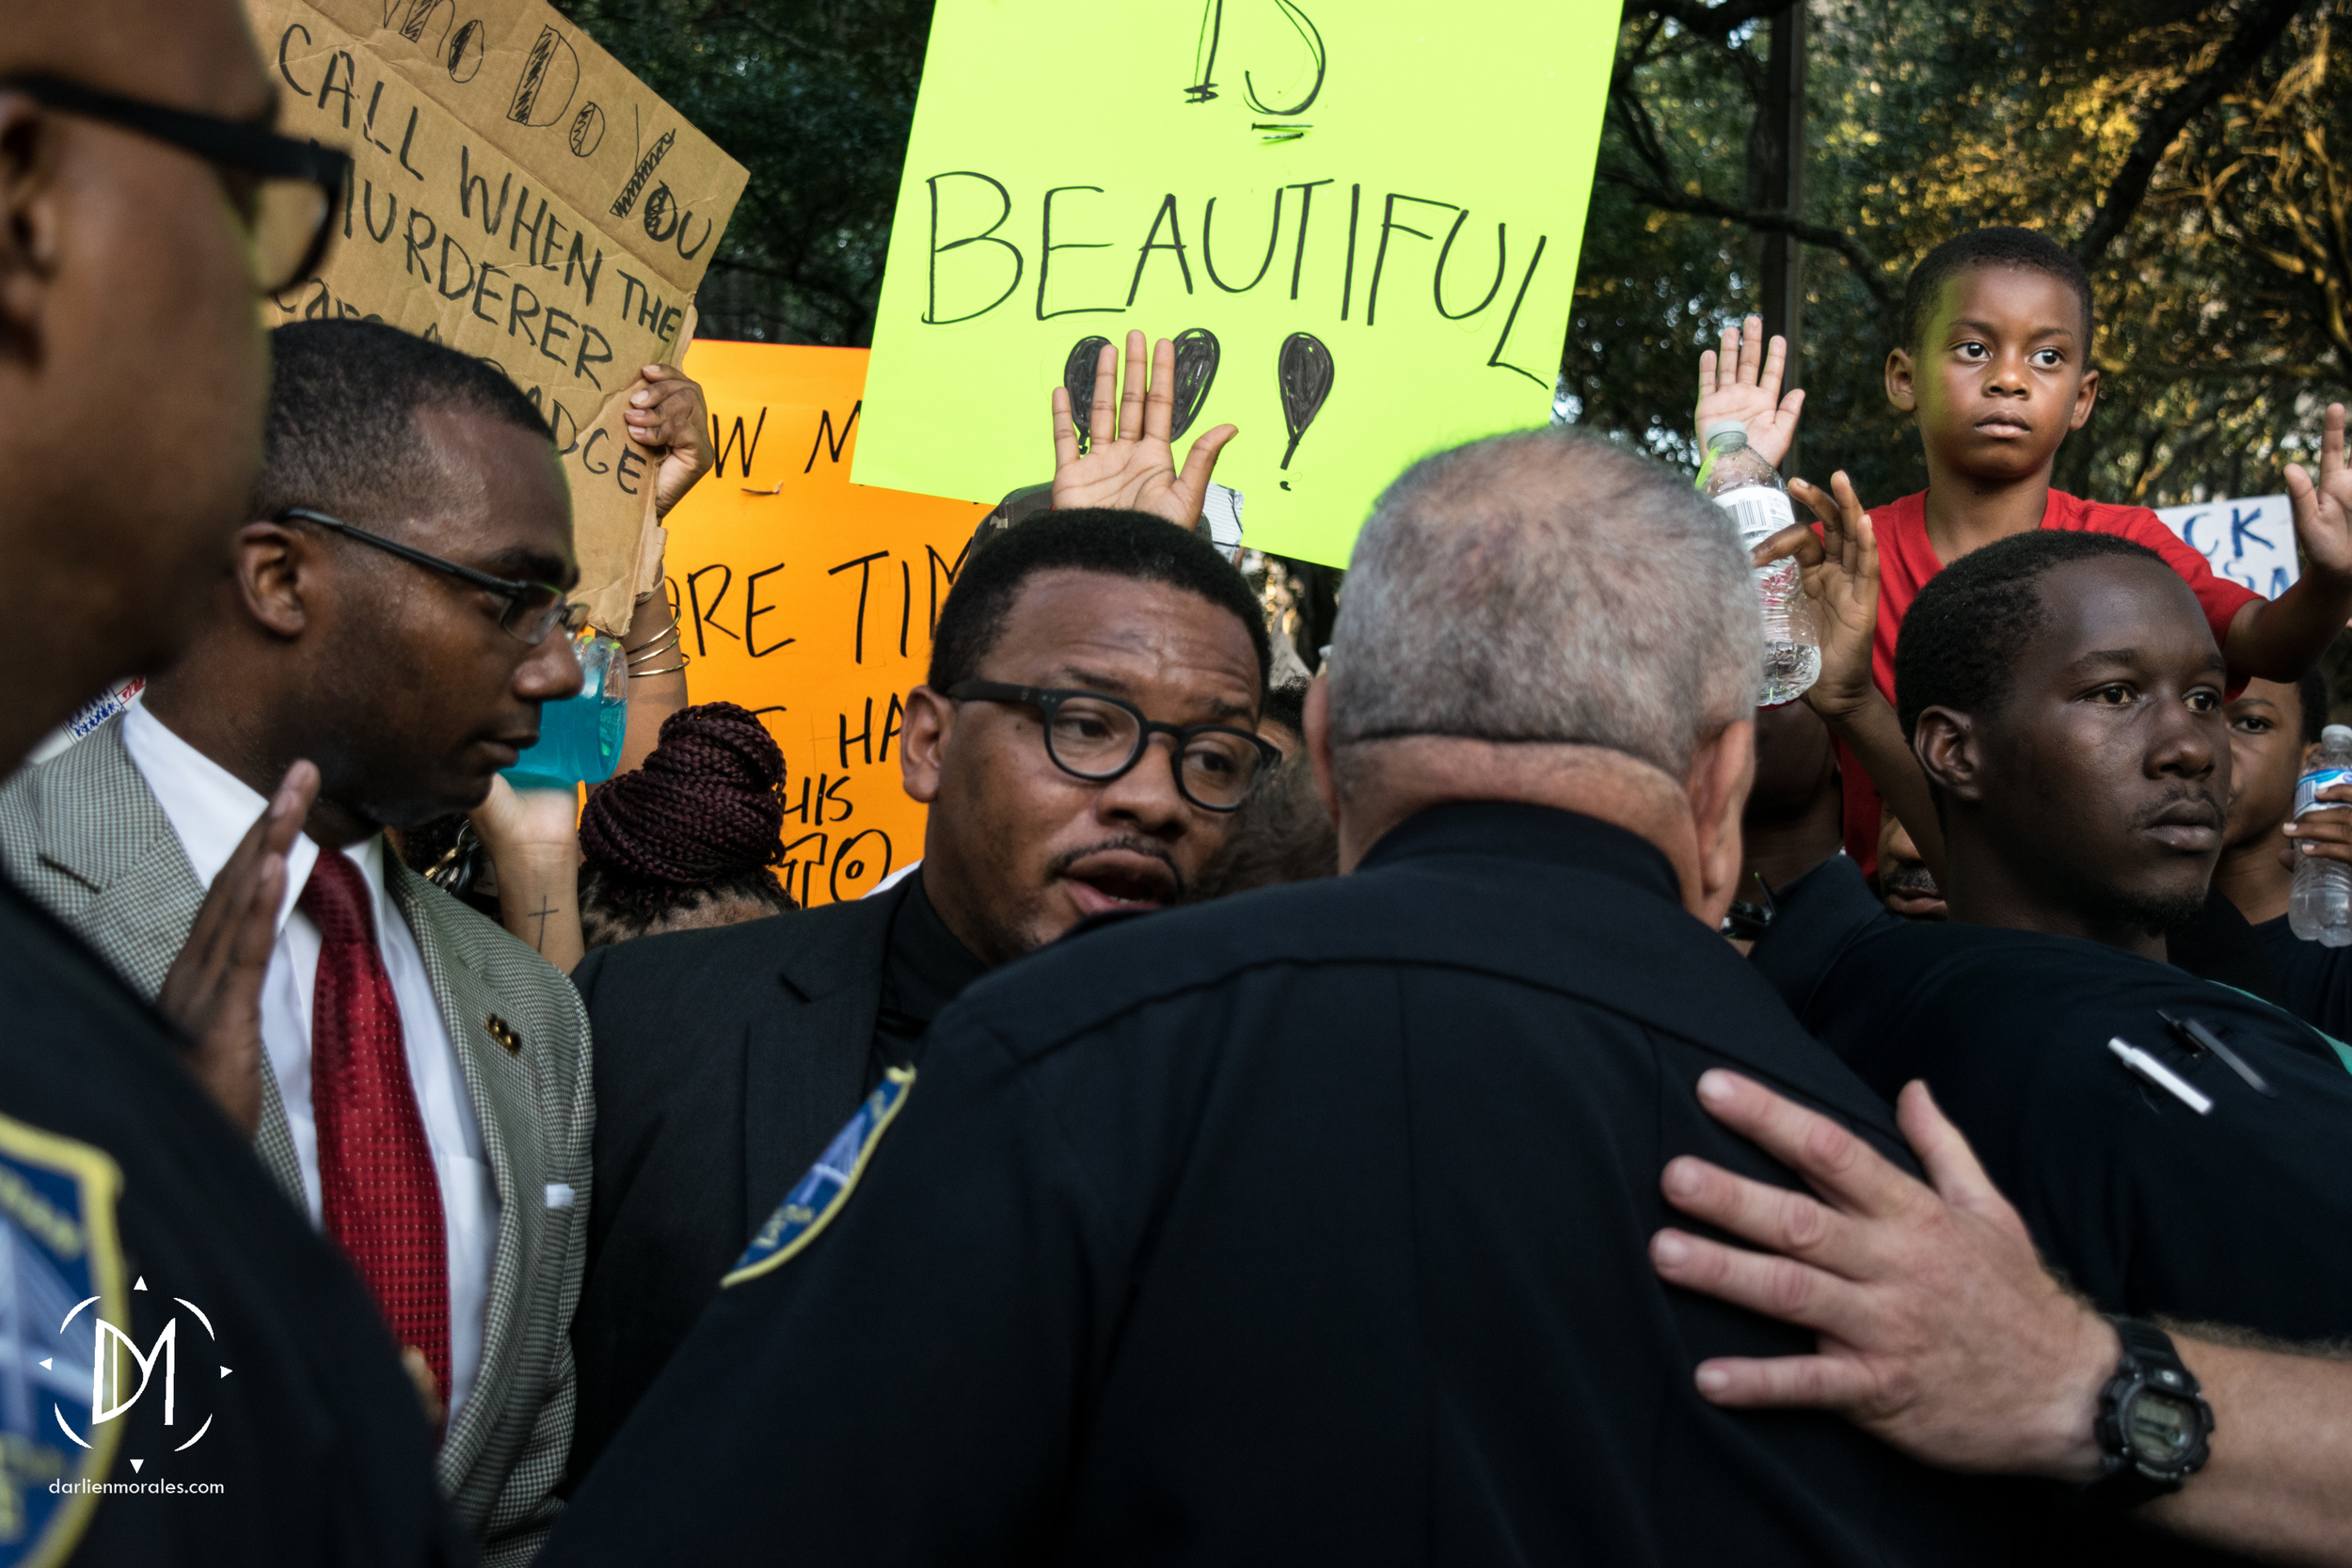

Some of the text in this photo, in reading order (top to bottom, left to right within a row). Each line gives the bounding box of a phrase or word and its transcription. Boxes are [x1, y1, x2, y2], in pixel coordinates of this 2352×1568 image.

[279, 24, 682, 342] CALL WHEN THE
[922, 171, 1549, 390] BEAUTIFUL
[2183, 507, 2276, 559] CK
[664, 536, 974, 664] RE TIM
[839, 692, 905, 768] HA
